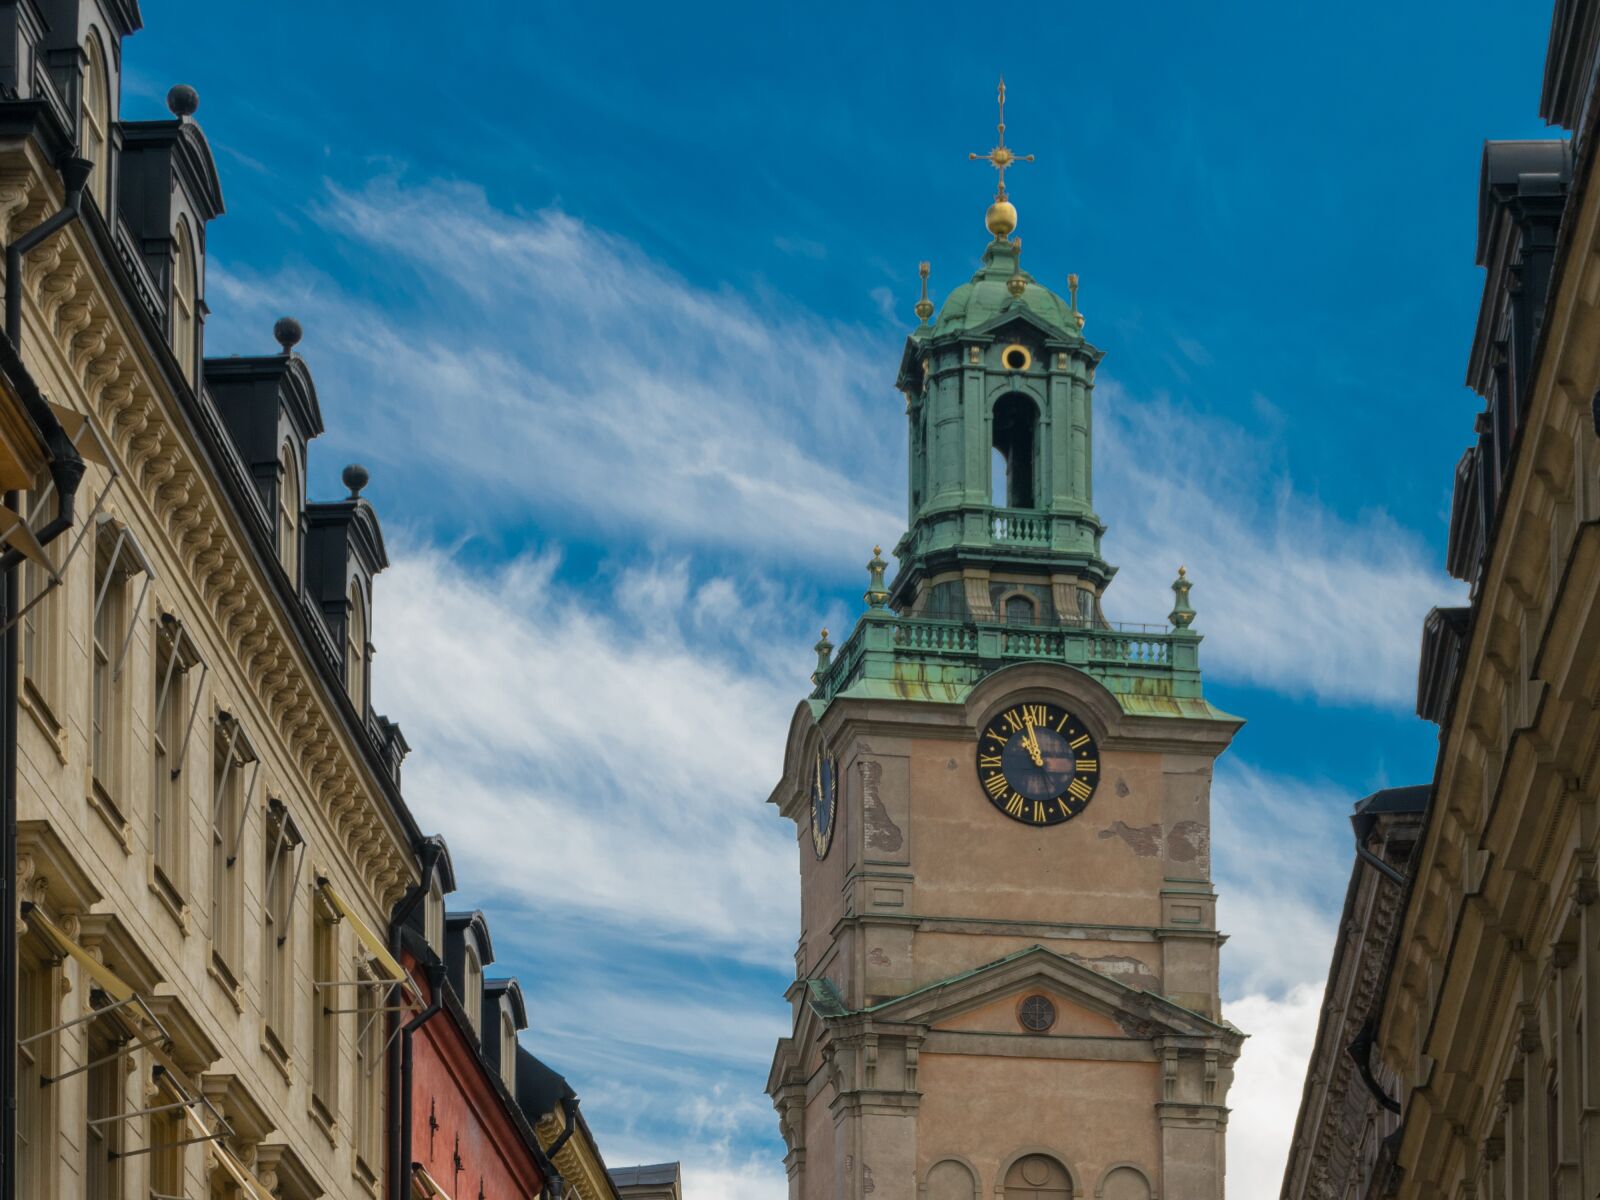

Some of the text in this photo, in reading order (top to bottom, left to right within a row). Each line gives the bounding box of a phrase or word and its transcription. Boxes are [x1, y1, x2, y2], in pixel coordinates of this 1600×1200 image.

[1003, 709, 1023, 733] XI
[1056, 713, 1069, 732] I
[987, 728, 1008, 746] X
[1070, 734, 1090, 749] II
[981, 754, 1001, 767] IX
[1076, 760, 1096, 771] III
[985, 774, 1009, 800] VIII
[1005, 792, 1024, 817] VII
[1034, 801, 1046, 822] VI
[1057, 797, 1072, 816] V
